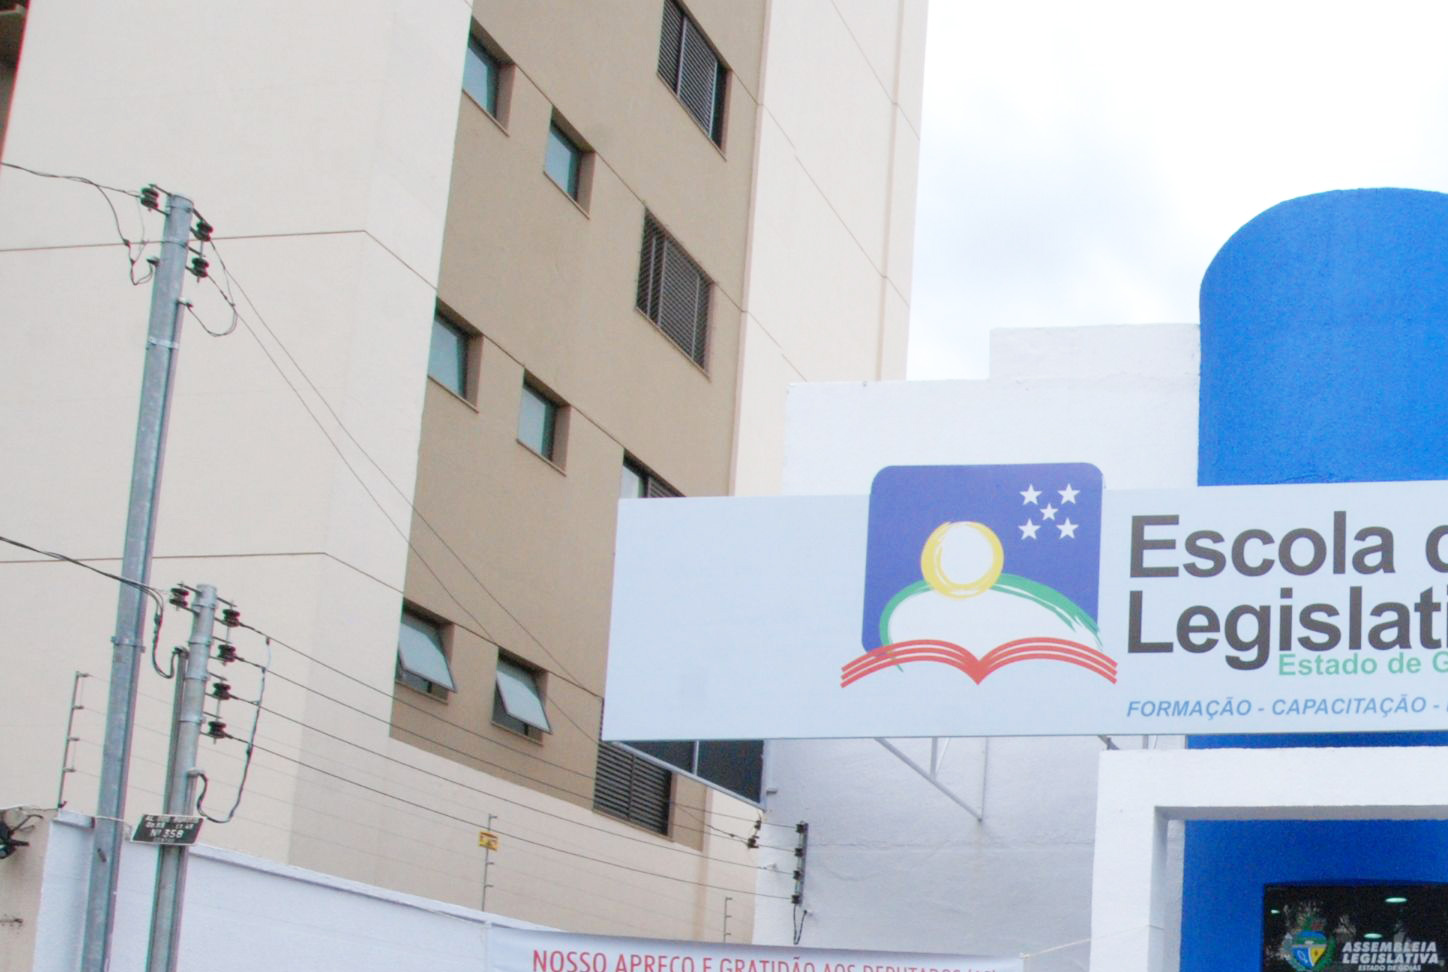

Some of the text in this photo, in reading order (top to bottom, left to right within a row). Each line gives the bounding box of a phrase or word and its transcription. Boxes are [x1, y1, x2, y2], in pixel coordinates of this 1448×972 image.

[1129, 510, 1396, 579] Escola
[1278, 652, 1378, 676] Estado
[1387, 651, 1422, 674] de
[1126, 696, 1252, 720] FORMAÇÃO
[1271, 694, 1427, 719] CAPACITAÇÃO
[1342, 941, 1438, 953] ASSEMBLEIA
[1342, 953, 1440, 964] LEGISLATIVA
